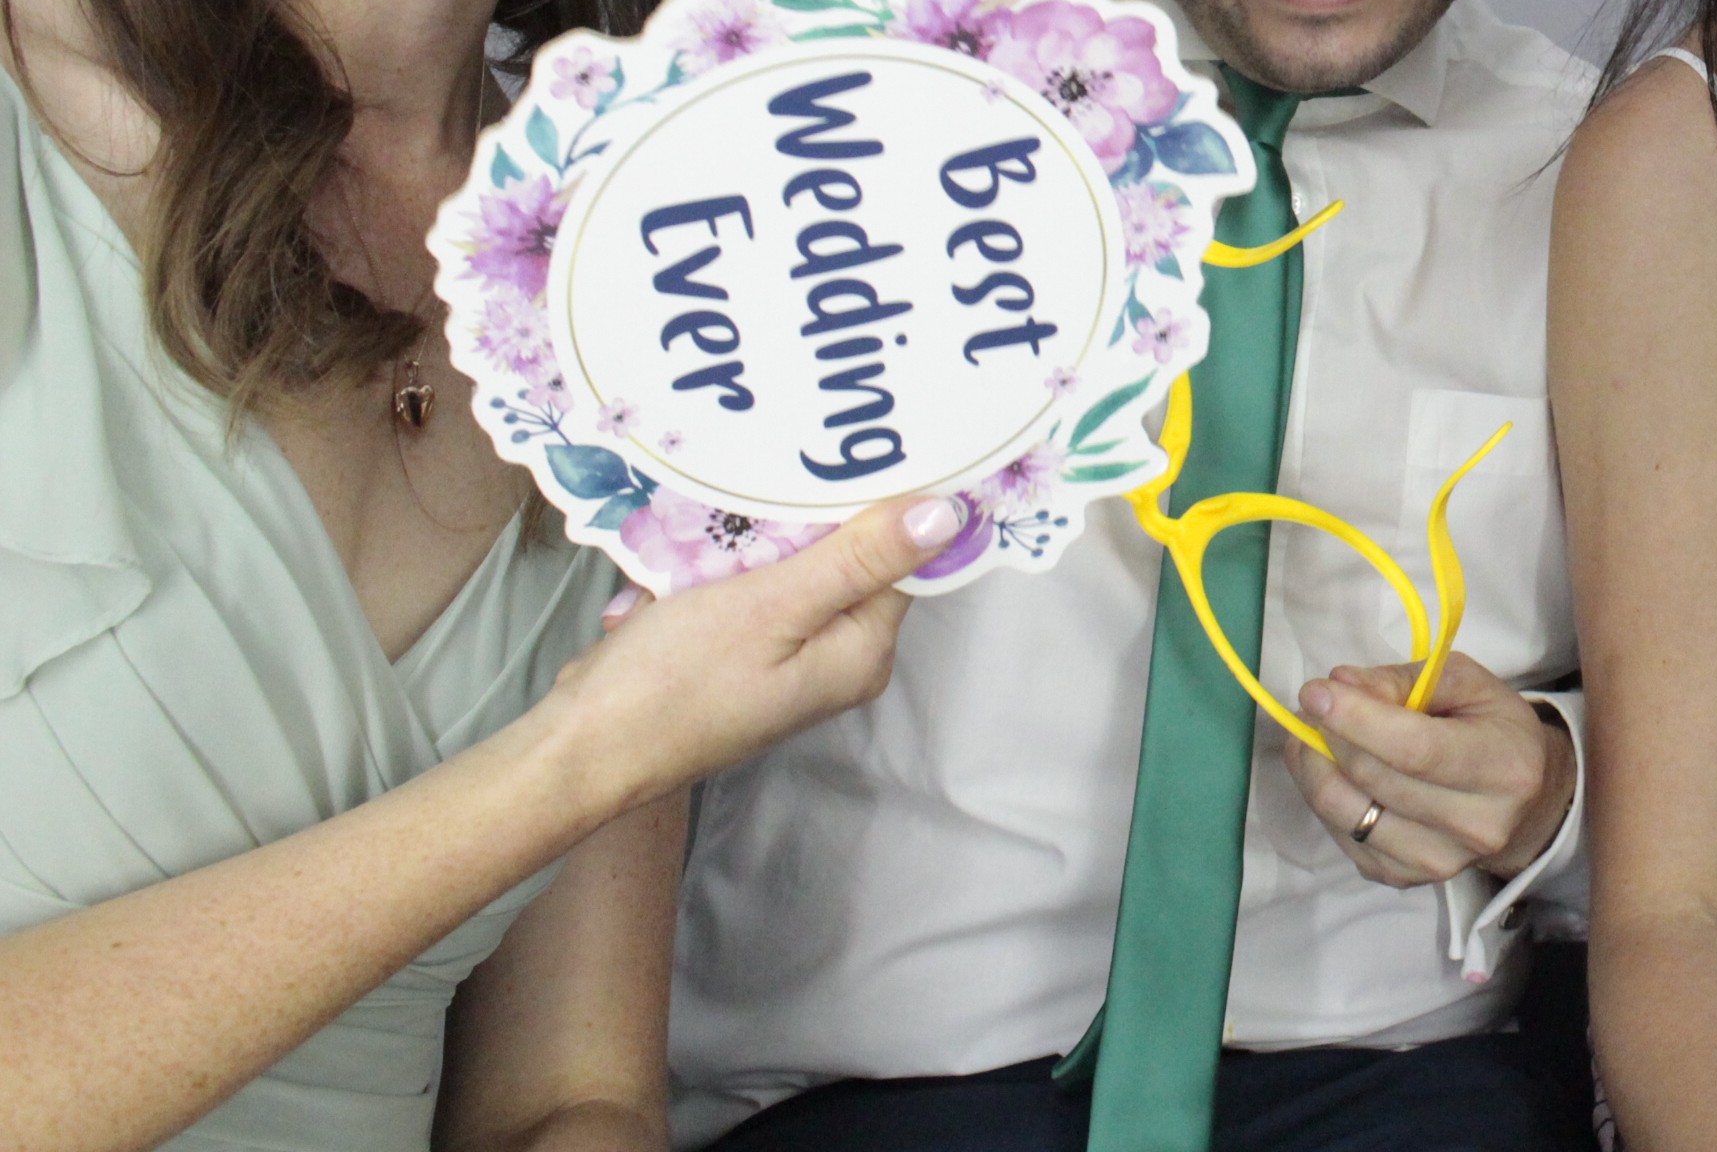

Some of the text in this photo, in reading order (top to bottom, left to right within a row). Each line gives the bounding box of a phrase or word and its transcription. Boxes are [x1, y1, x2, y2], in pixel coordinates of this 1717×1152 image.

[640, 195, 755, 412] Ever
[767, 72, 913, 481] Wedding
[938, 137, 1059, 366] Best
